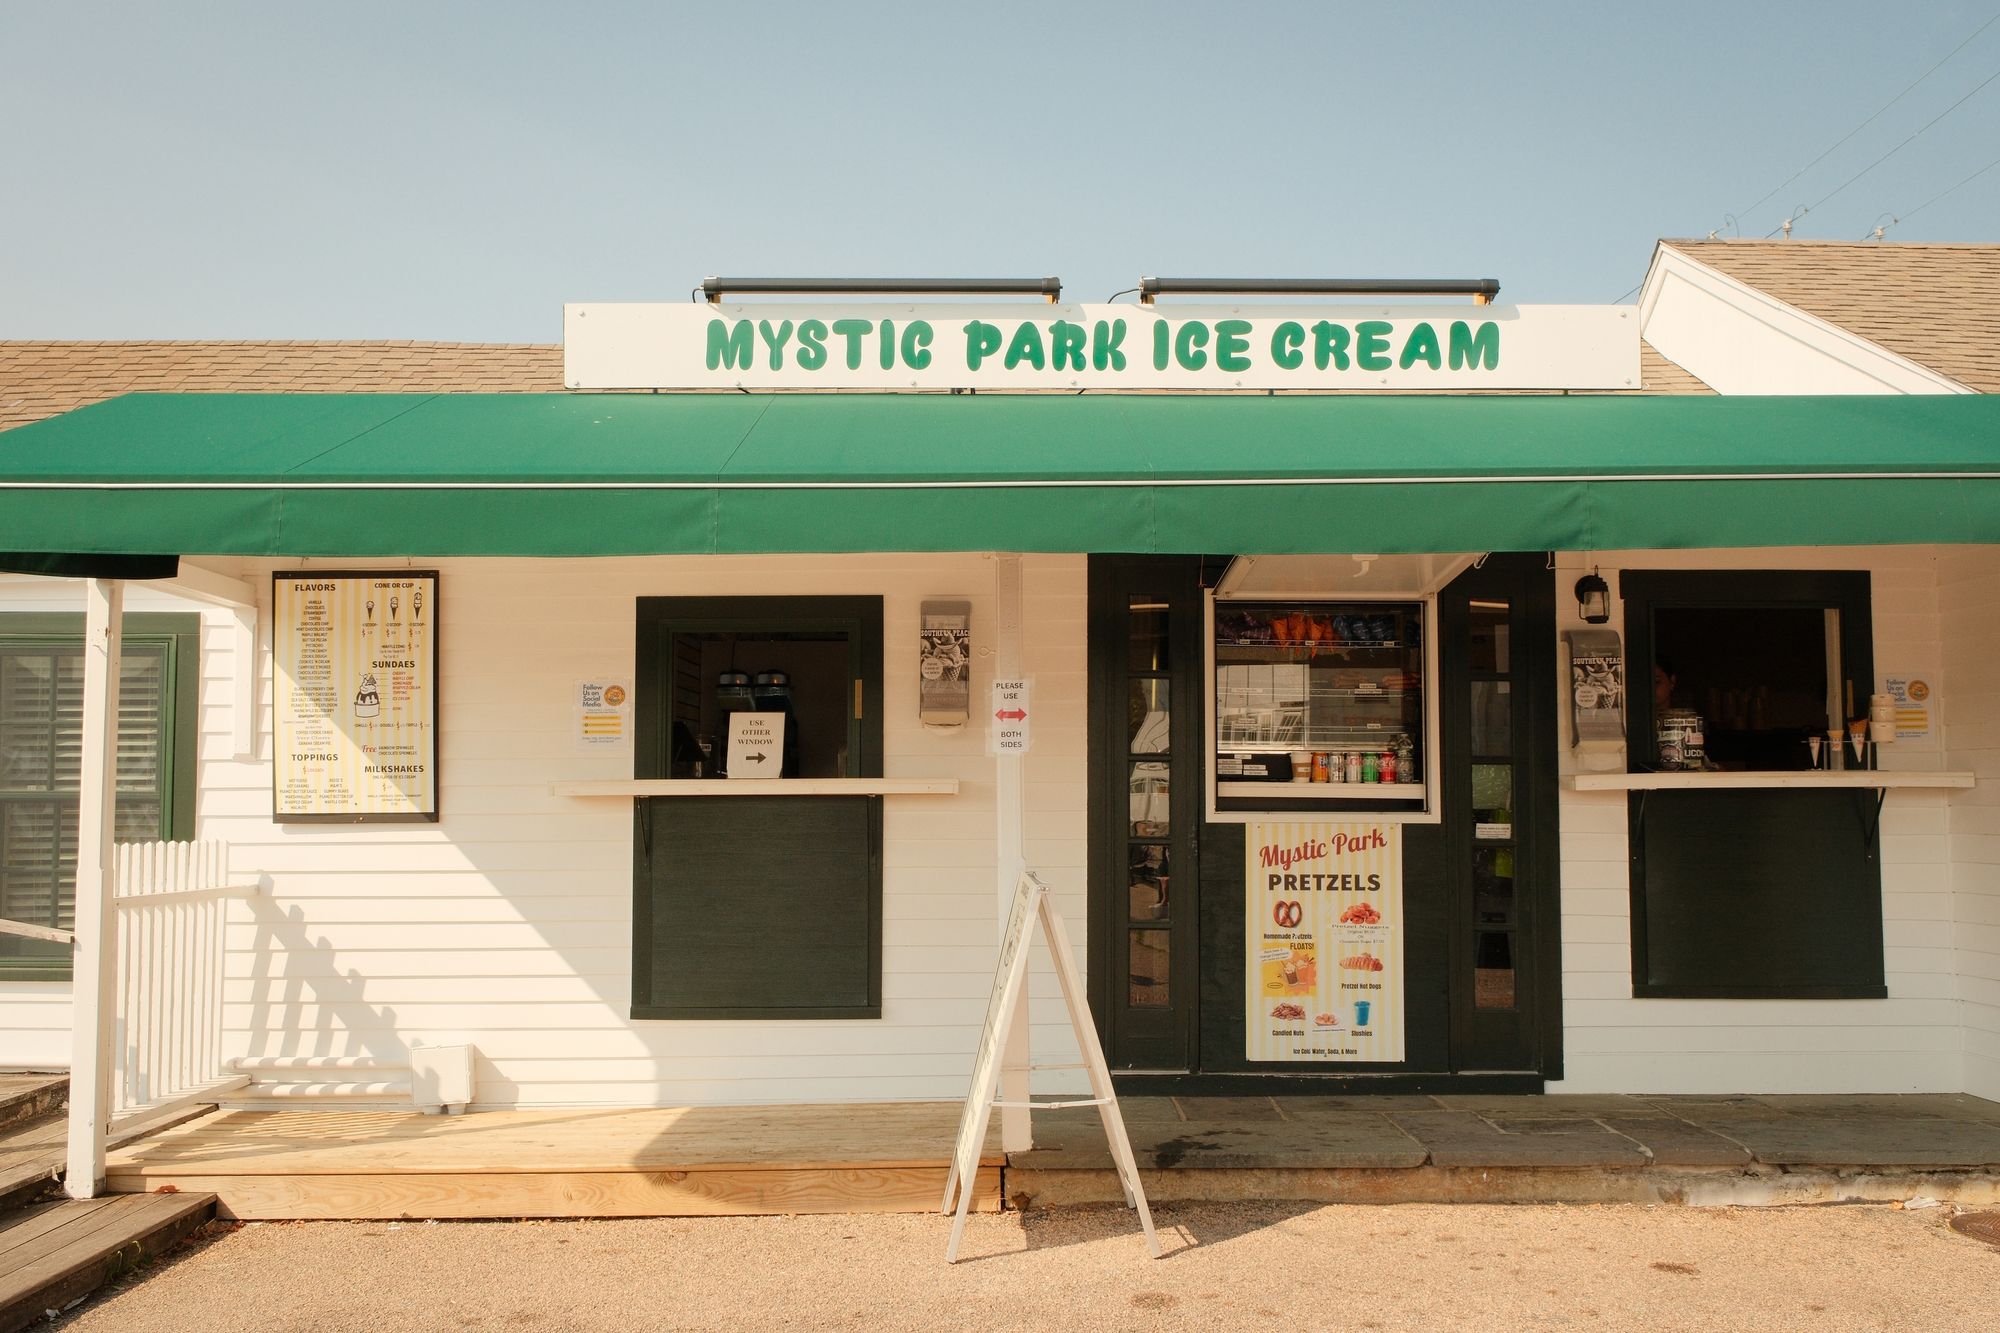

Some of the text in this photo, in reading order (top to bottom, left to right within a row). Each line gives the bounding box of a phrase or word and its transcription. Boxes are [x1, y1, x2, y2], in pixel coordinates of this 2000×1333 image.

[707, 320, 1500, 371] MYSTIC PARK ICE CREAM
[364, 765, 424, 773] MILKSHAKES
[1260, 829, 1387, 871] Mystic Park
[1268, 874, 1380, 891] PRETZELS
